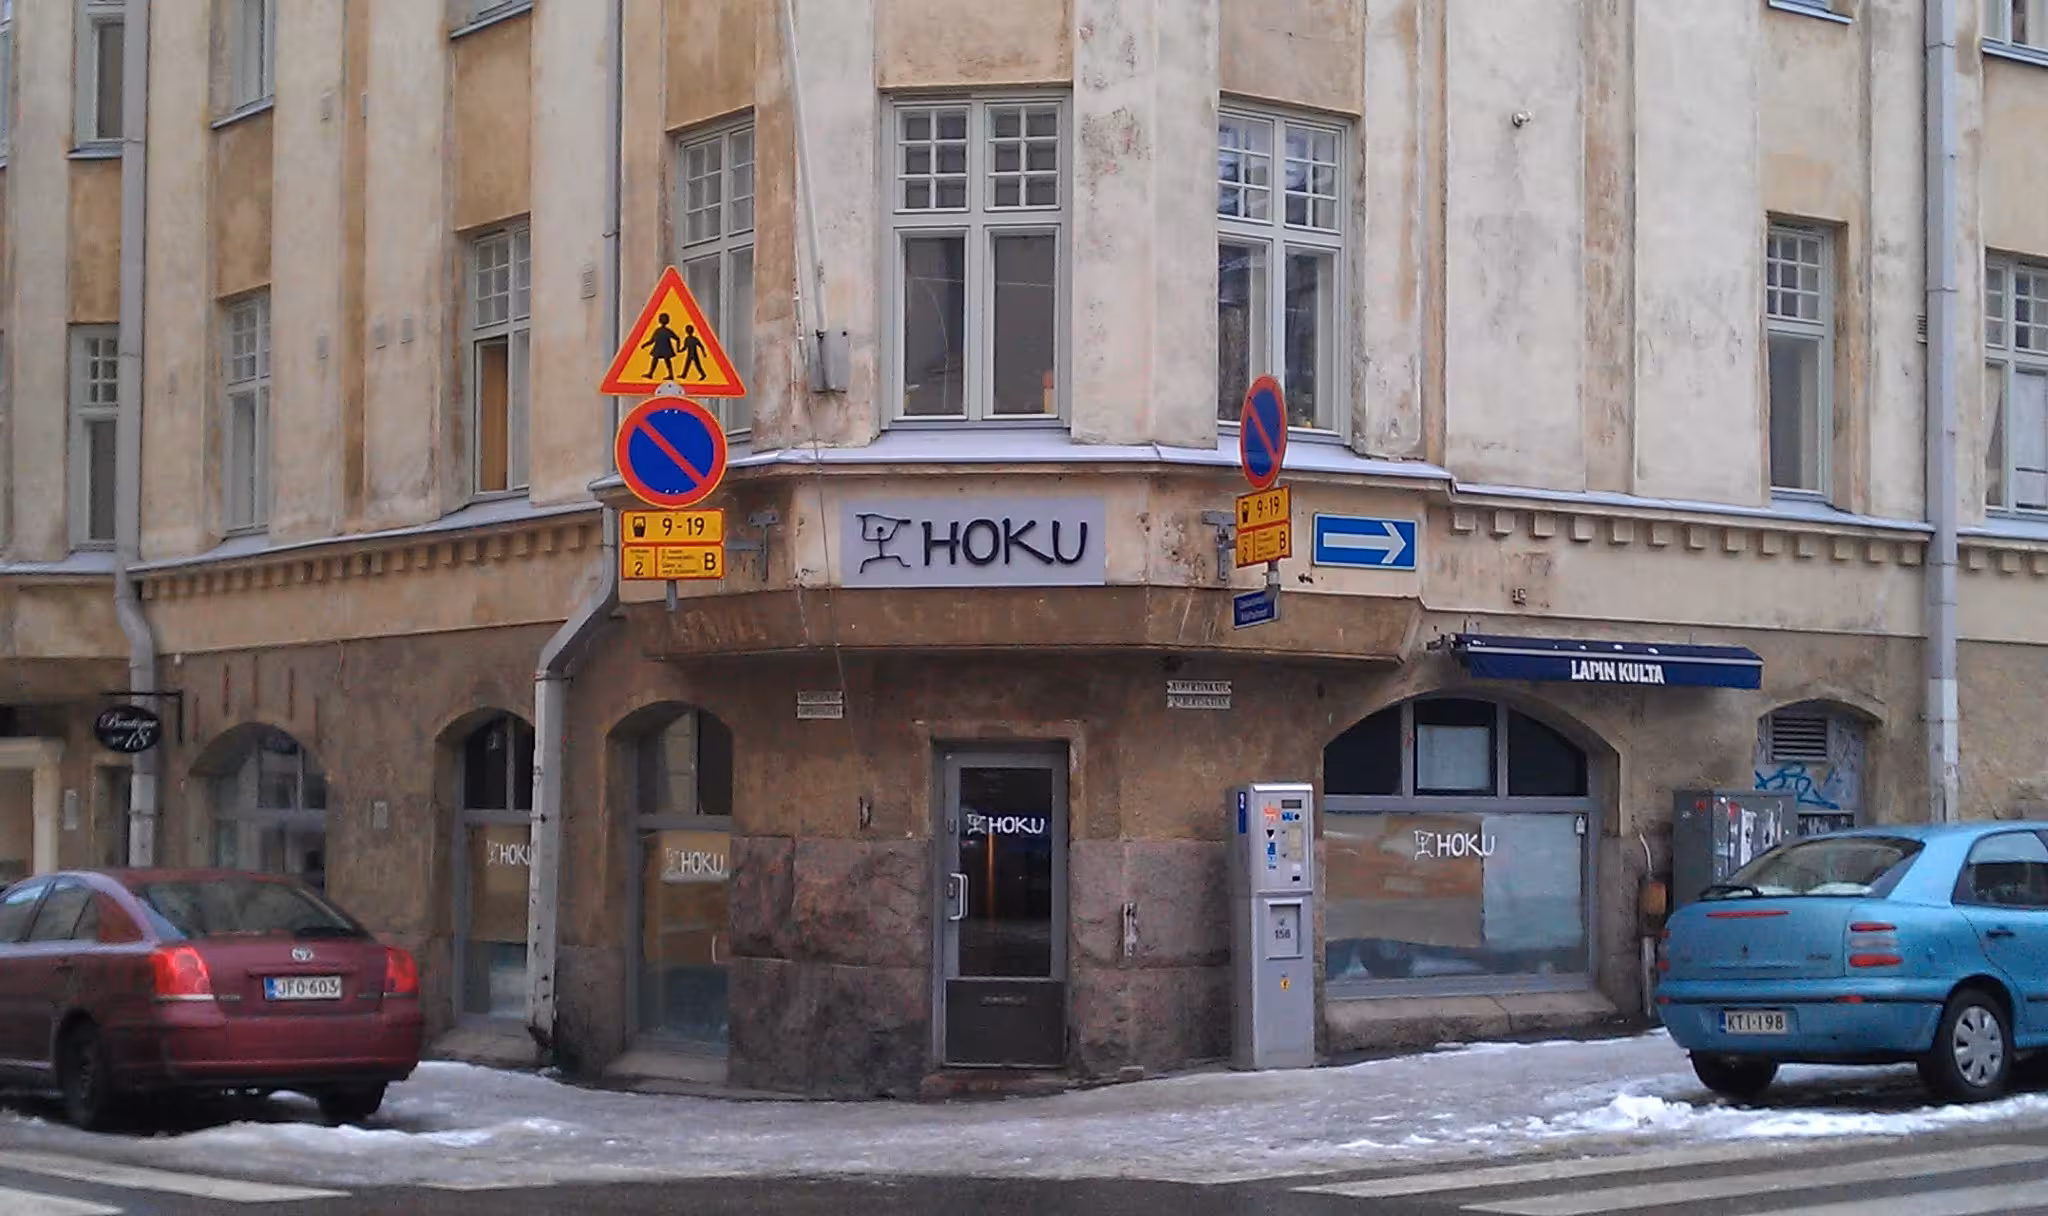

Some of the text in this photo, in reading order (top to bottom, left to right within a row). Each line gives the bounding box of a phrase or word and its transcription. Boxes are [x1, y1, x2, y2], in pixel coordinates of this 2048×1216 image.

[921, 517, 1088, 566] HOKU
[635, 561, 644, 576] 2
[704, 552, 716, 571] B
[1571, 660, 1665, 684] LAPIN KULTA
[987, 816, 1045, 834] HOKU
[1437, 833, 1495, 857] HOKU
[680, 851, 724, 874] HOKU
